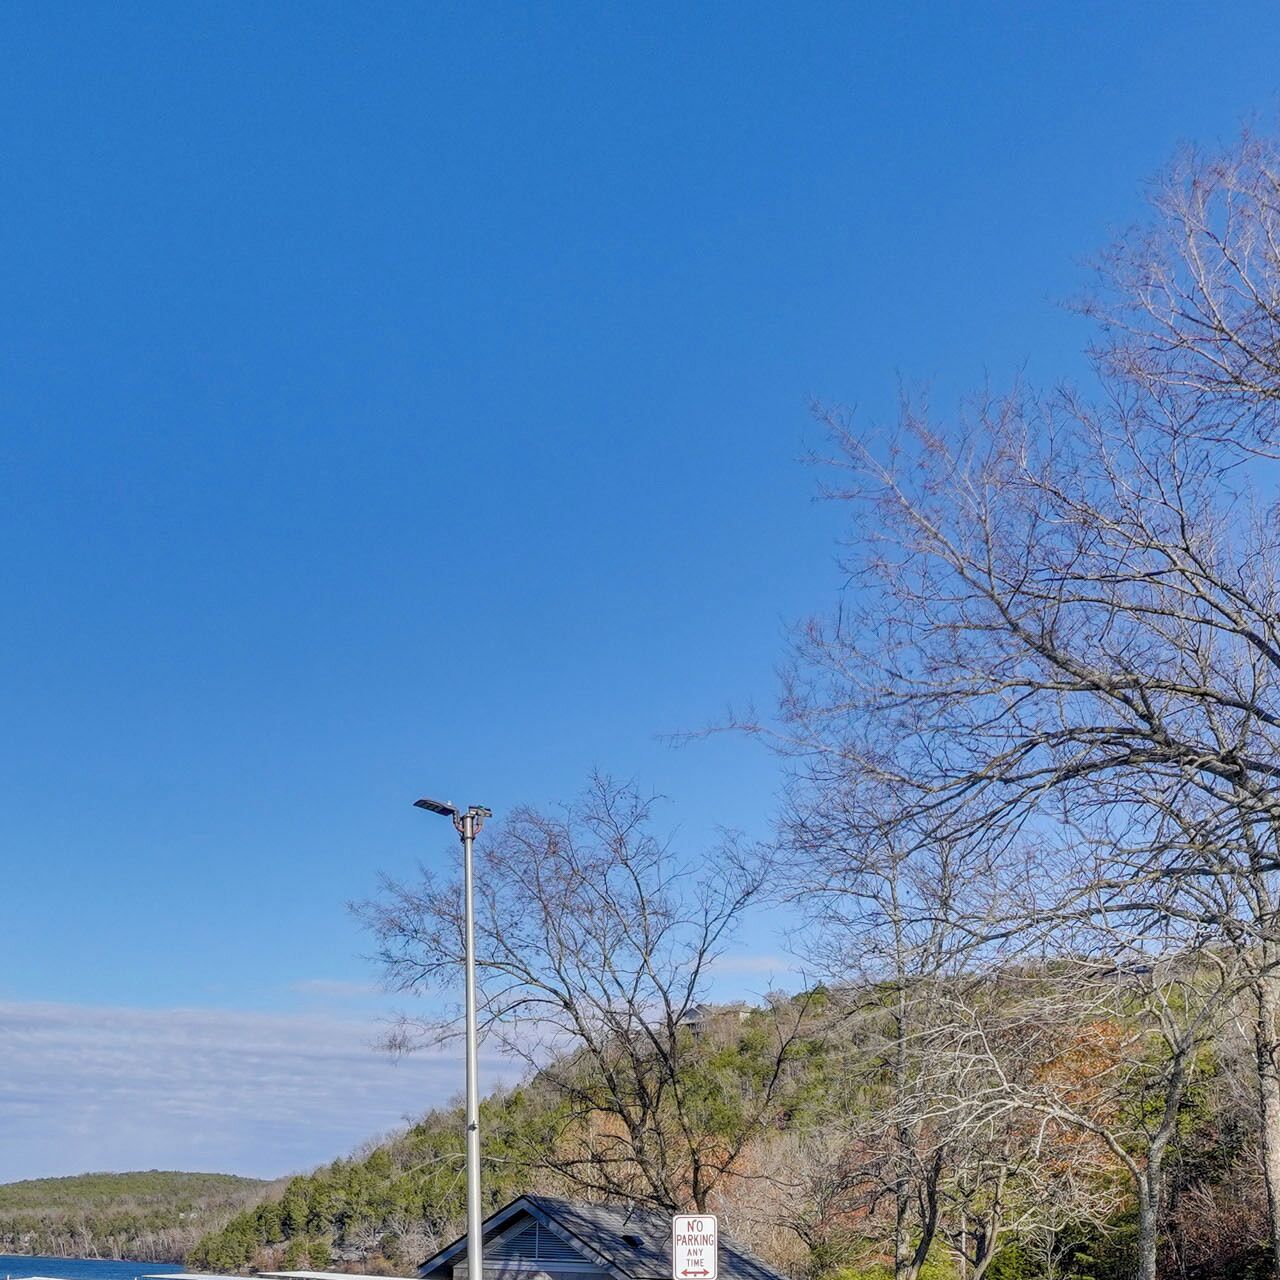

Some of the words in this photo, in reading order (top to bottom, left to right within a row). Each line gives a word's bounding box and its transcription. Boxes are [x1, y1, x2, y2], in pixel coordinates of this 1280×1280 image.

[687, 1220, 704, 1232] NO
[676, 1234, 714, 1246] PARKING
[687, 1248, 704, 1257] ANY
[686, 1258, 704, 1267] TIME
